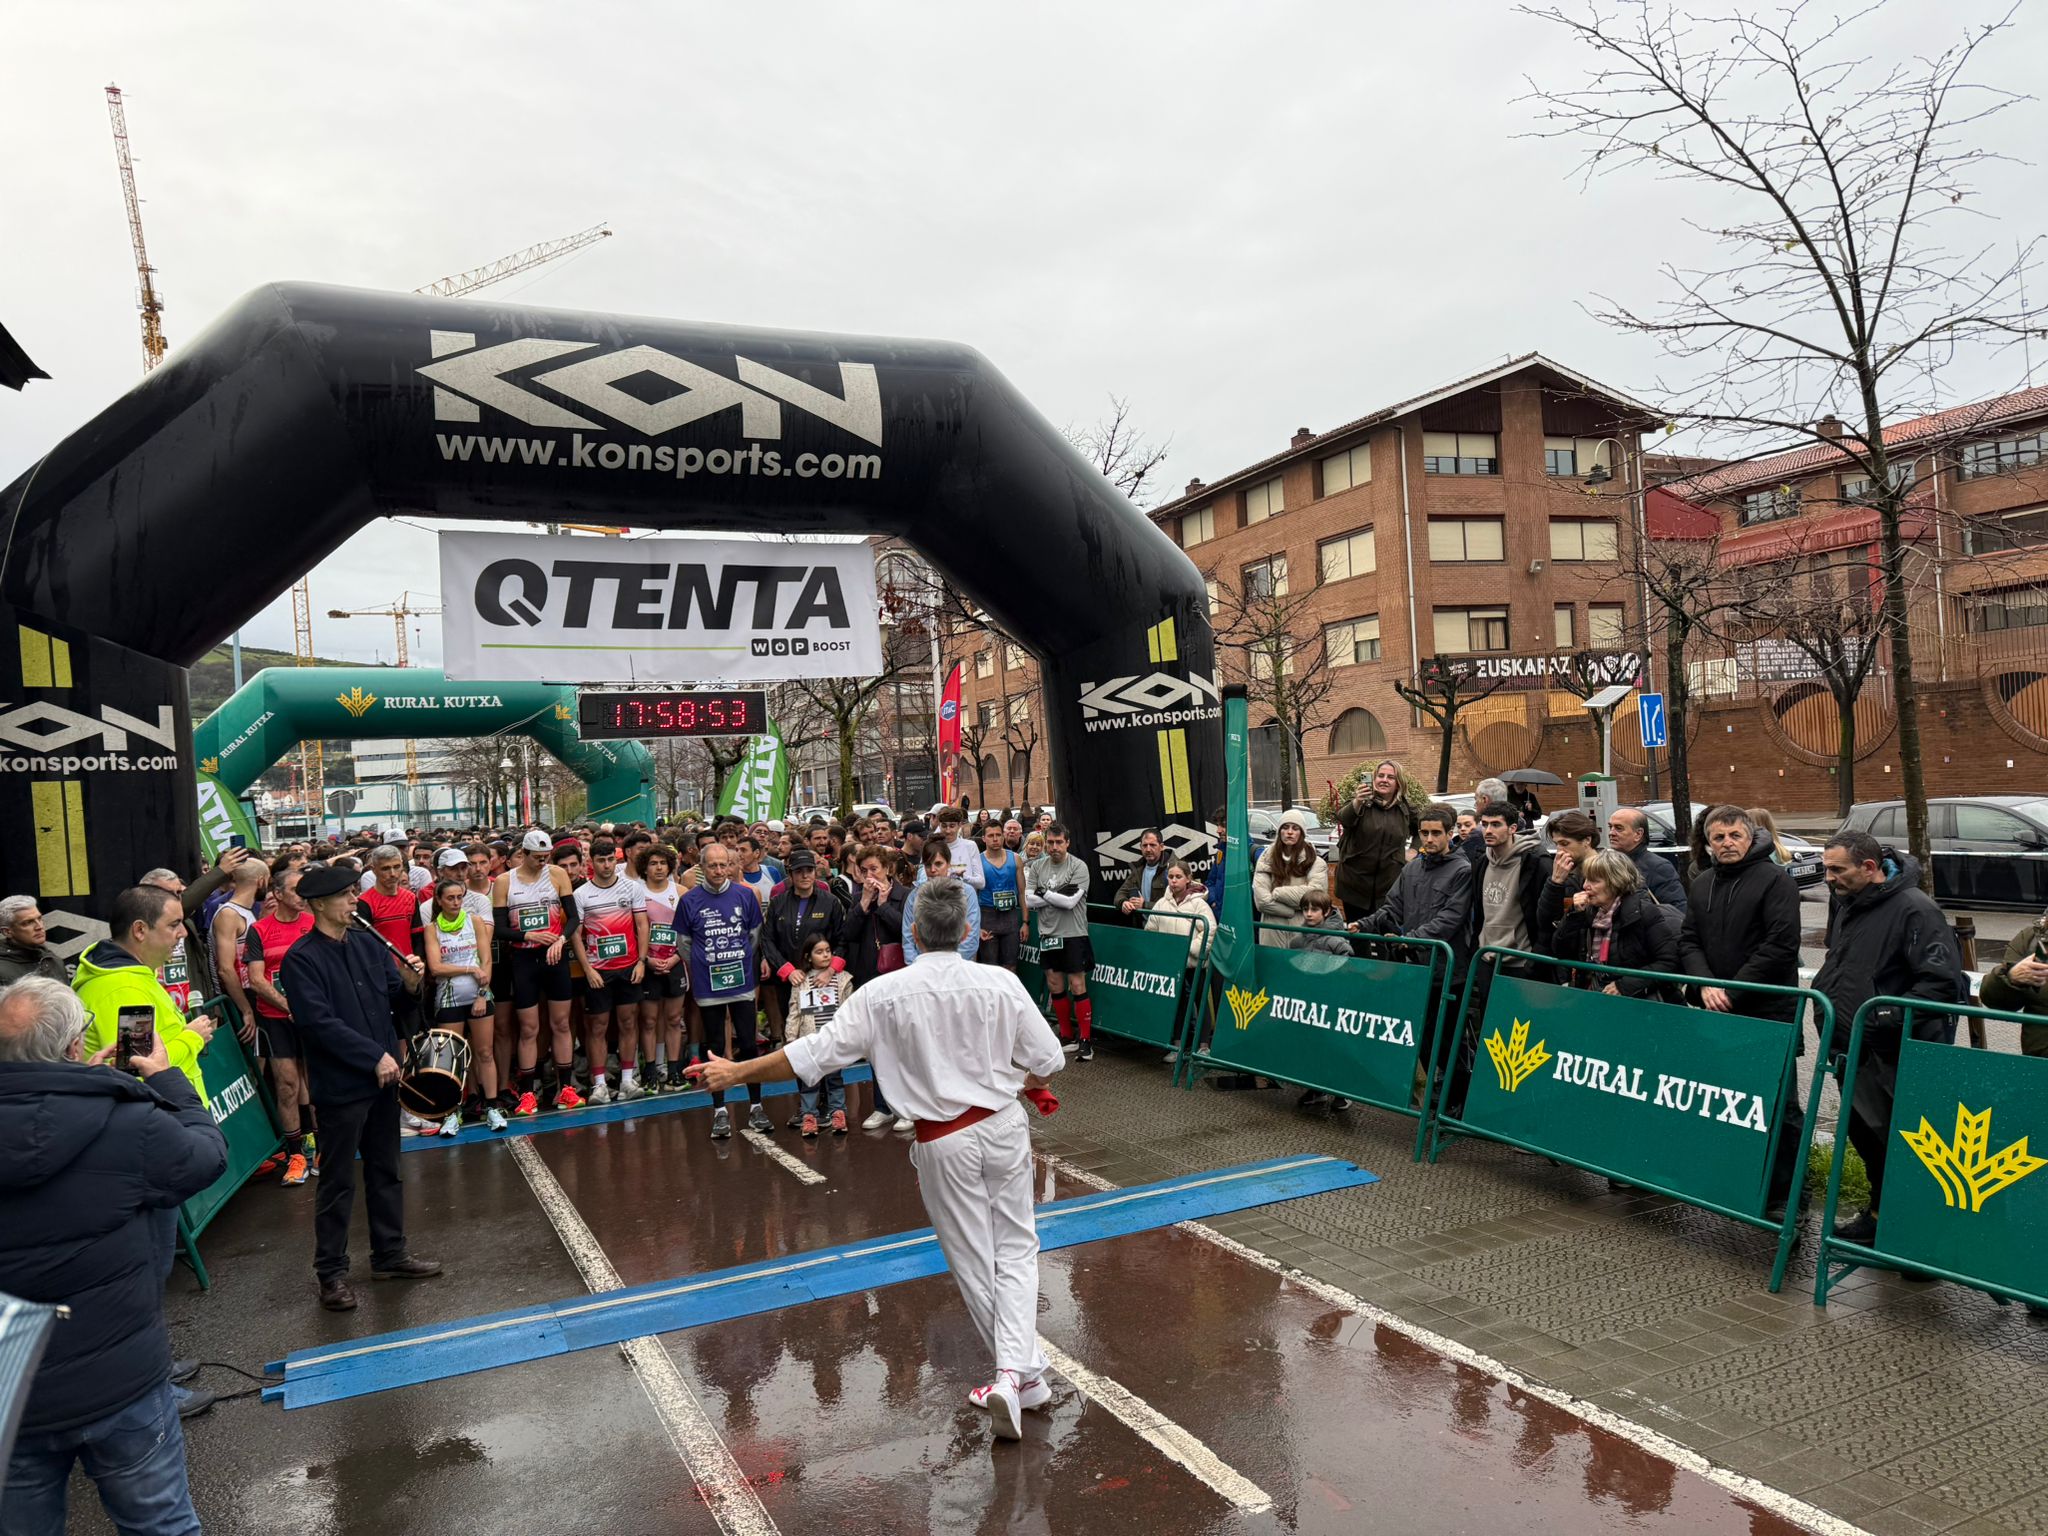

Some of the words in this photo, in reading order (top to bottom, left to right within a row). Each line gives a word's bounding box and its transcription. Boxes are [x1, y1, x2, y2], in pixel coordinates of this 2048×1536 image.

[414, 329, 883, 448] KON
[436, 433, 882, 479] www.konsports.com
[474, 558, 851, 630] QTENTA
[812, 641, 851, 652] BOOST
[384, 696, 440, 709] RURAL
[443, 695, 503, 708] KUTXA
[615, 700, 746, 729] 17:58:53
[0, 700, 177, 753] ON
[219, 735, 248, 759] RURAL
[245, 711, 275, 737] KUTXA
[524, 915, 545, 927] 601
[655, 932, 671, 942] 394
[603, 944, 621, 955] 108
[169, 966, 186, 980] 514
[721, 974, 735, 985] 32
[1091, 962, 1130, 989] RURAL
[1130, 970, 1176, 998] KUTXA
[1269, 994, 1331, 1029] RURAL
[1334, 1007, 1415, 1047] KUTXA
[220, 1073, 256, 1115] KUTXA
[1552, 1050, 1648, 1101] RURAL
[1653, 1074, 1768, 1133] KUTXA
